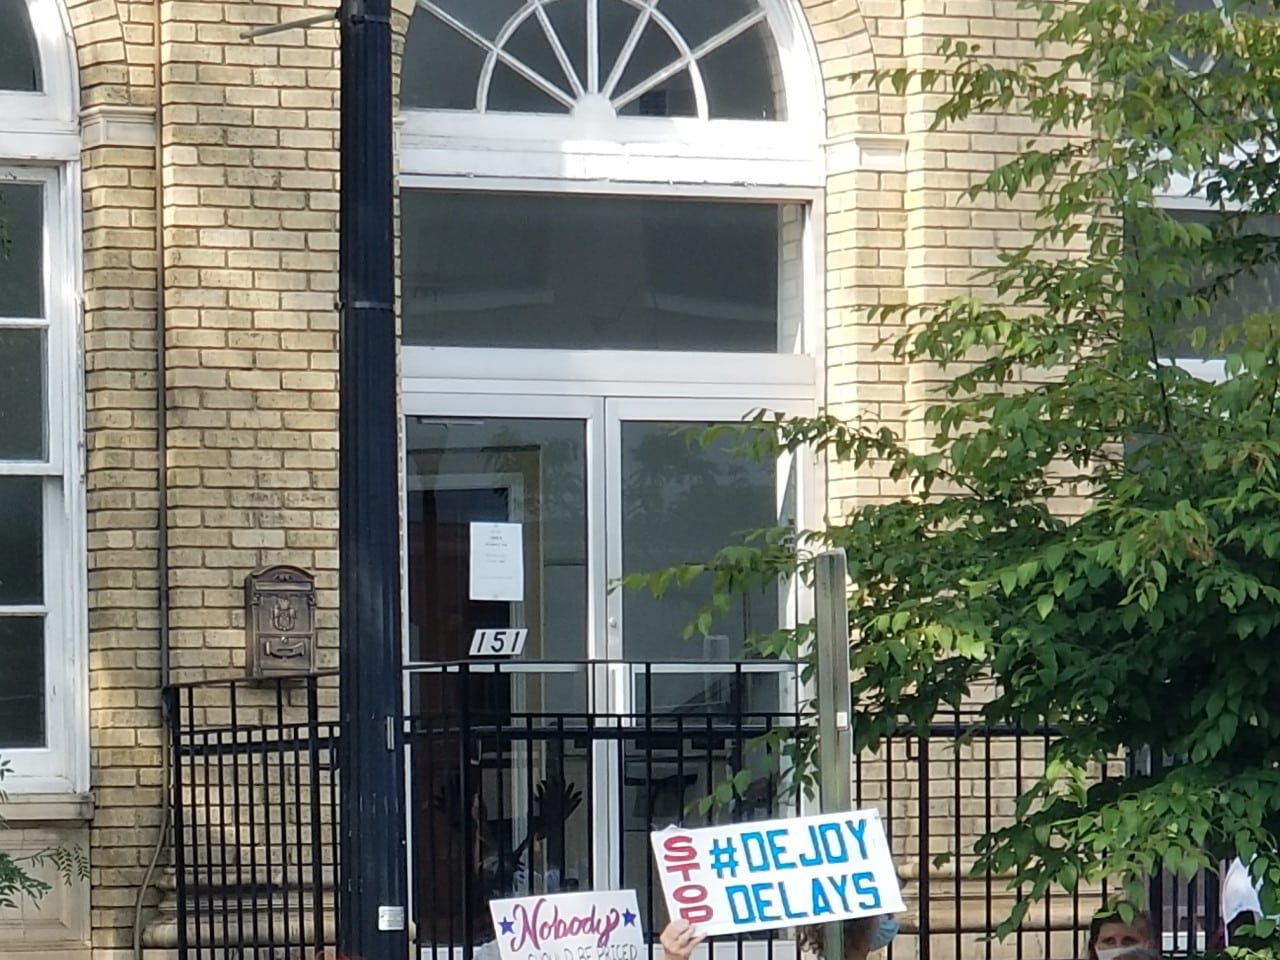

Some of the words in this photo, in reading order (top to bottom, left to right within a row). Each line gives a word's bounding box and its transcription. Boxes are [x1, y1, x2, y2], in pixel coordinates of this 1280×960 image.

[477, 631, 521, 653] 151
[708, 818, 868, 879] #DEJOY
[663, 835, 714, 925] STOP
[725, 871, 883, 925] DELAYS
[510, 898, 620, 952] Nobody
